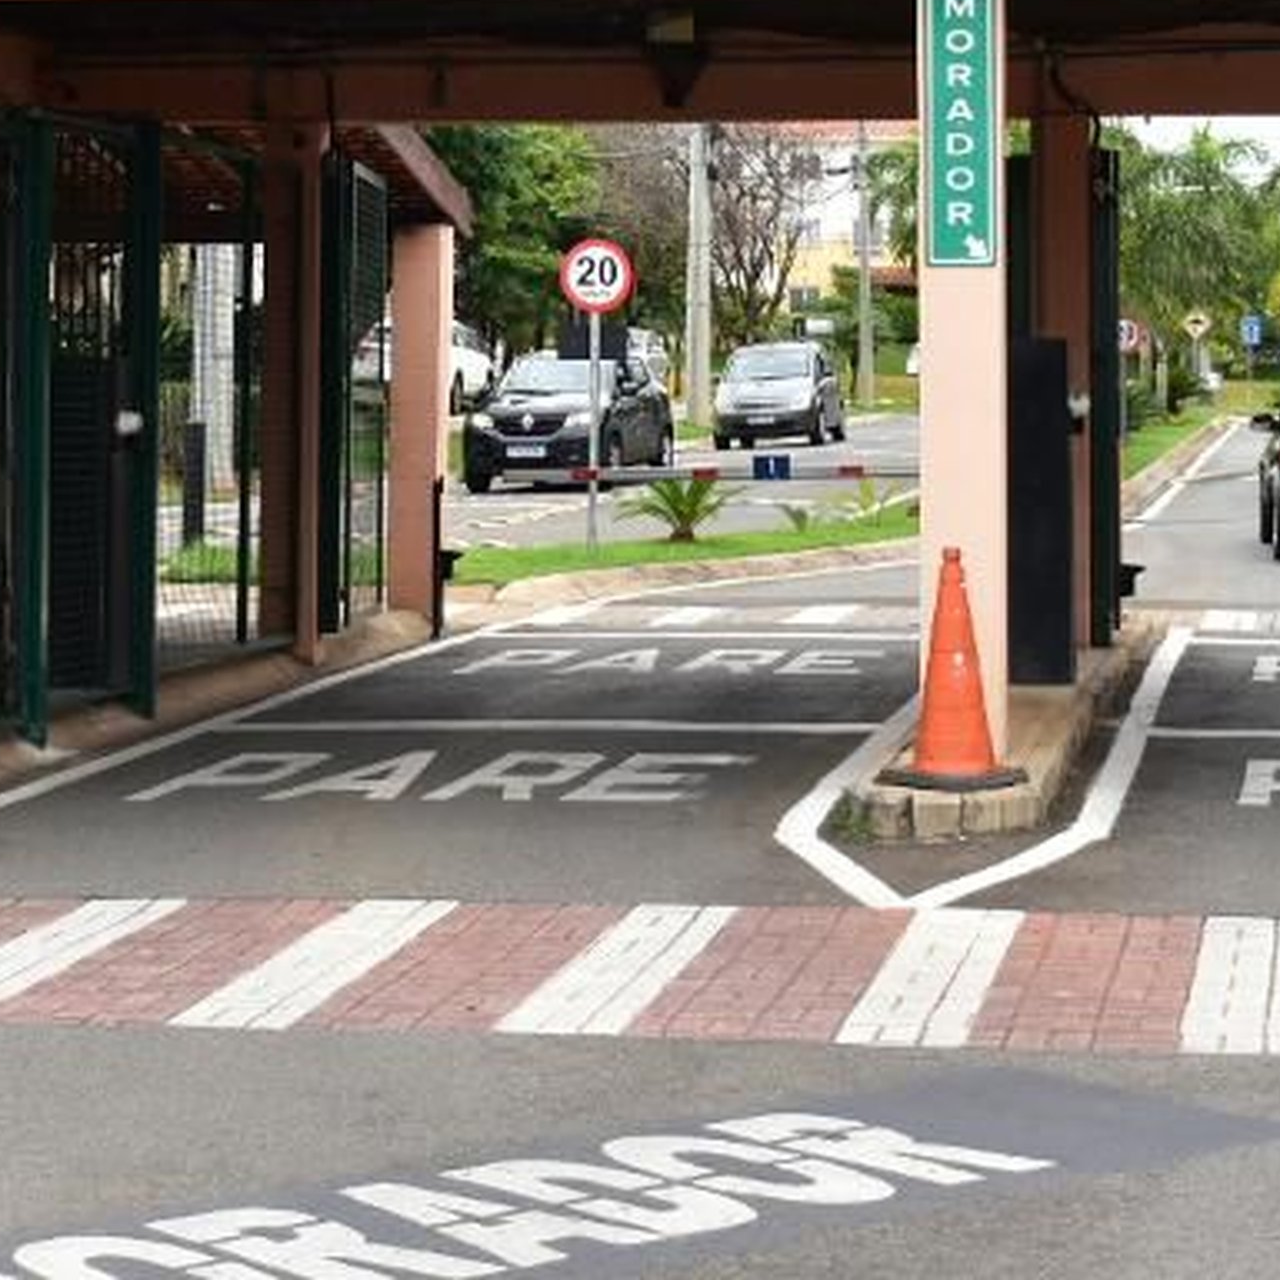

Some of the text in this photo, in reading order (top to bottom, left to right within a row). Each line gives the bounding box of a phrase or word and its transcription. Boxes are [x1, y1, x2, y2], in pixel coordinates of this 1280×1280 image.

[577, 255, 618, 288] 20
[452, 648, 890, 676] PARE
[124, 750, 760, 802] PARE
